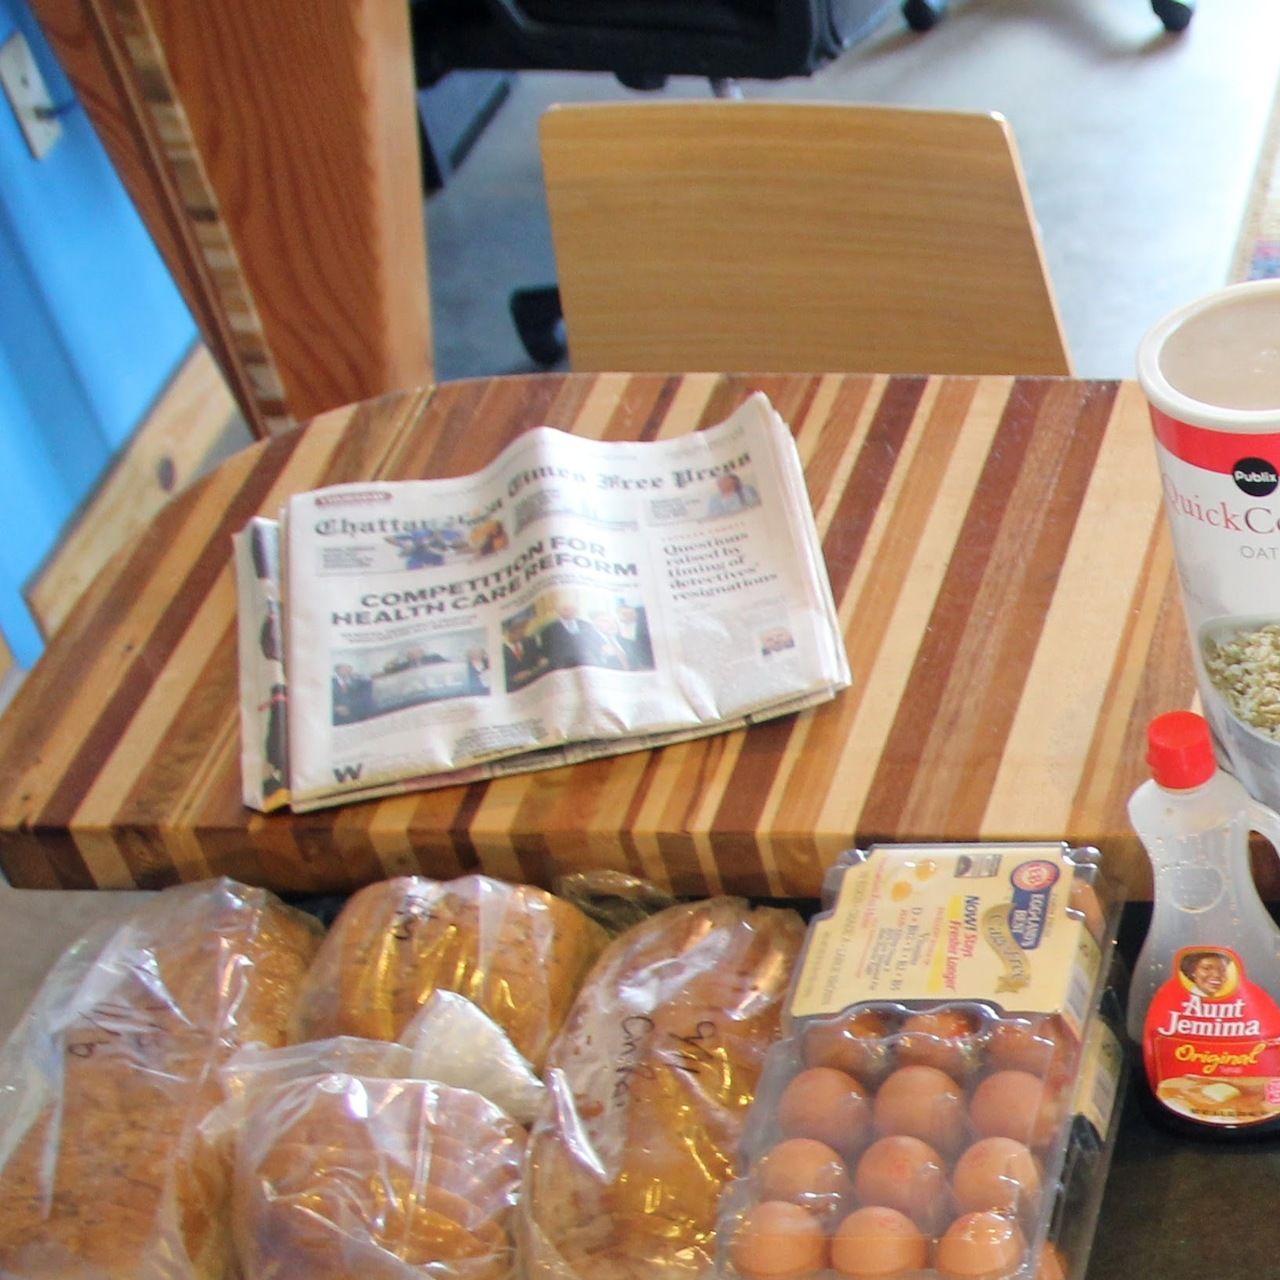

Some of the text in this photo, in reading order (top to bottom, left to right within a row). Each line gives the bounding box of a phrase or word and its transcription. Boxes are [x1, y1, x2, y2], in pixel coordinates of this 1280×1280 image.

[508, 463, 587, 497] Times
[597, 473, 663, 491] Free
[673, 452, 752, 488] Press
[1234, 469, 1278, 483] Publix
[664, 533, 749, 556] Questions
[361, 541, 543, 608] COMPETITION
[550, 534, 606, 556] FOR
[667, 550, 718, 566] raised
[331, 554, 638, 625] HEALTH CARE REFORM
[672, 573, 778, 601] resignations
[333, 763, 363, 783] W
[1011, 908, 1028, 934] BEST
[942, 955, 959, 992] Longer
[1181, 994, 1246, 1018] Aunt
[1157, 1010, 1261, 1036] Jemima
[1175, 1041, 1268, 1074] Original
